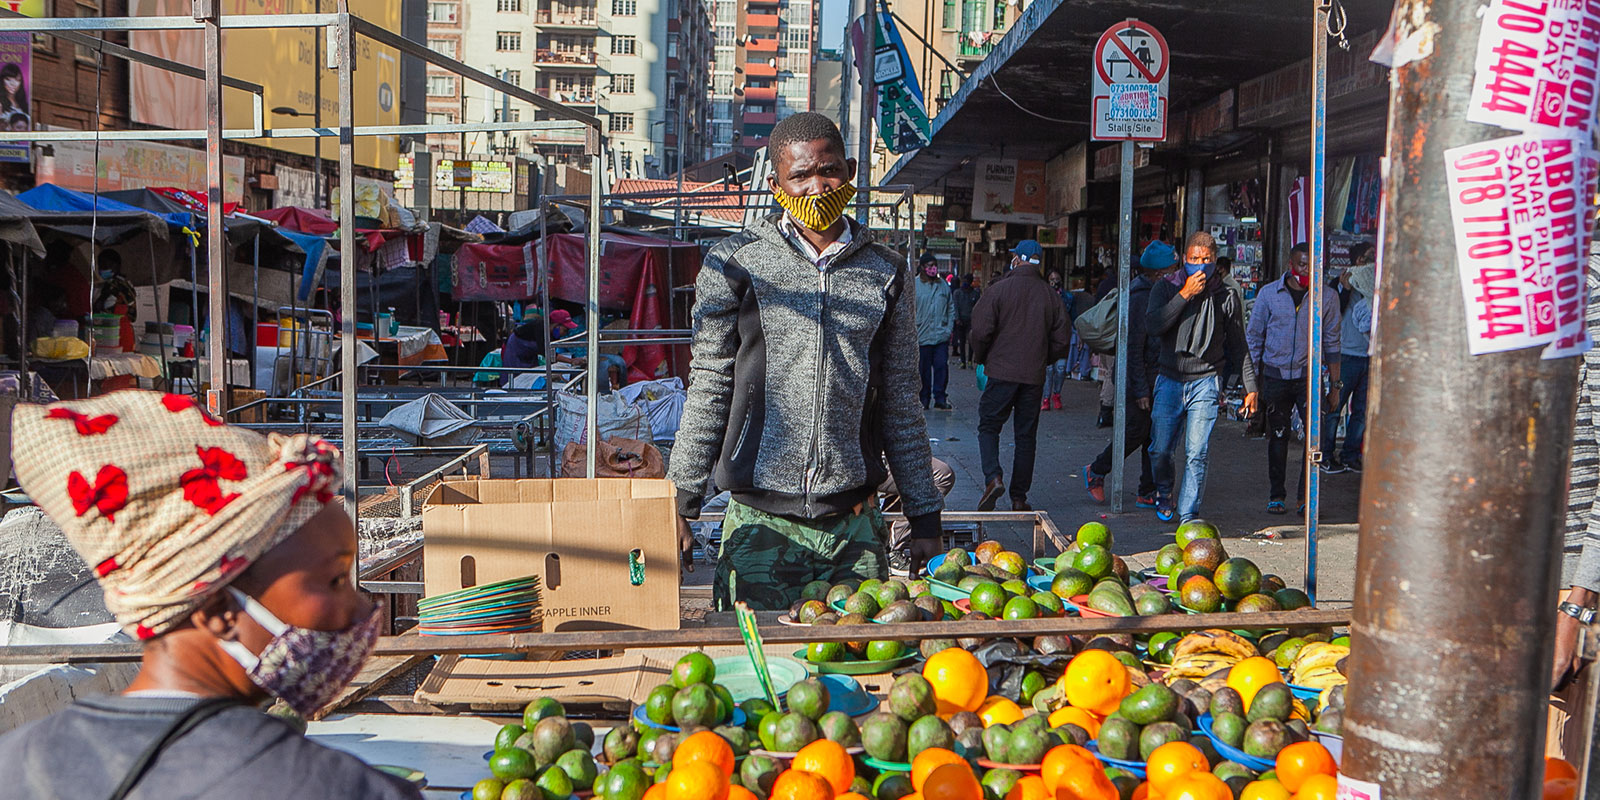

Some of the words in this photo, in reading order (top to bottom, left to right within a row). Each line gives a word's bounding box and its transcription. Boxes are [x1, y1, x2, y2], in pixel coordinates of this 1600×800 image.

[1481, 39, 1538, 115] 4444
[1542, 21, 1563, 75] DAY
[1558, 19, 1580, 81] PILLS
[1108, 122, 1152, 133] Stalls/Site
[986, 164, 1015, 175] PURNITA
[1454, 149, 1507, 205] 078
[1463, 207, 1513, 260] 770
[1505, 144, 1530, 224] SAME
[1518, 235, 1538, 286] DAY
[1523, 141, 1547, 218] SONAR
[1535, 227, 1554, 288] PILLS
[1541, 139, 1579, 327] ABORTION
[1473, 268, 1524, 339] 4444
[545, 608, 577, 618] APPLE
[580, 606, 611, 616] INNER
